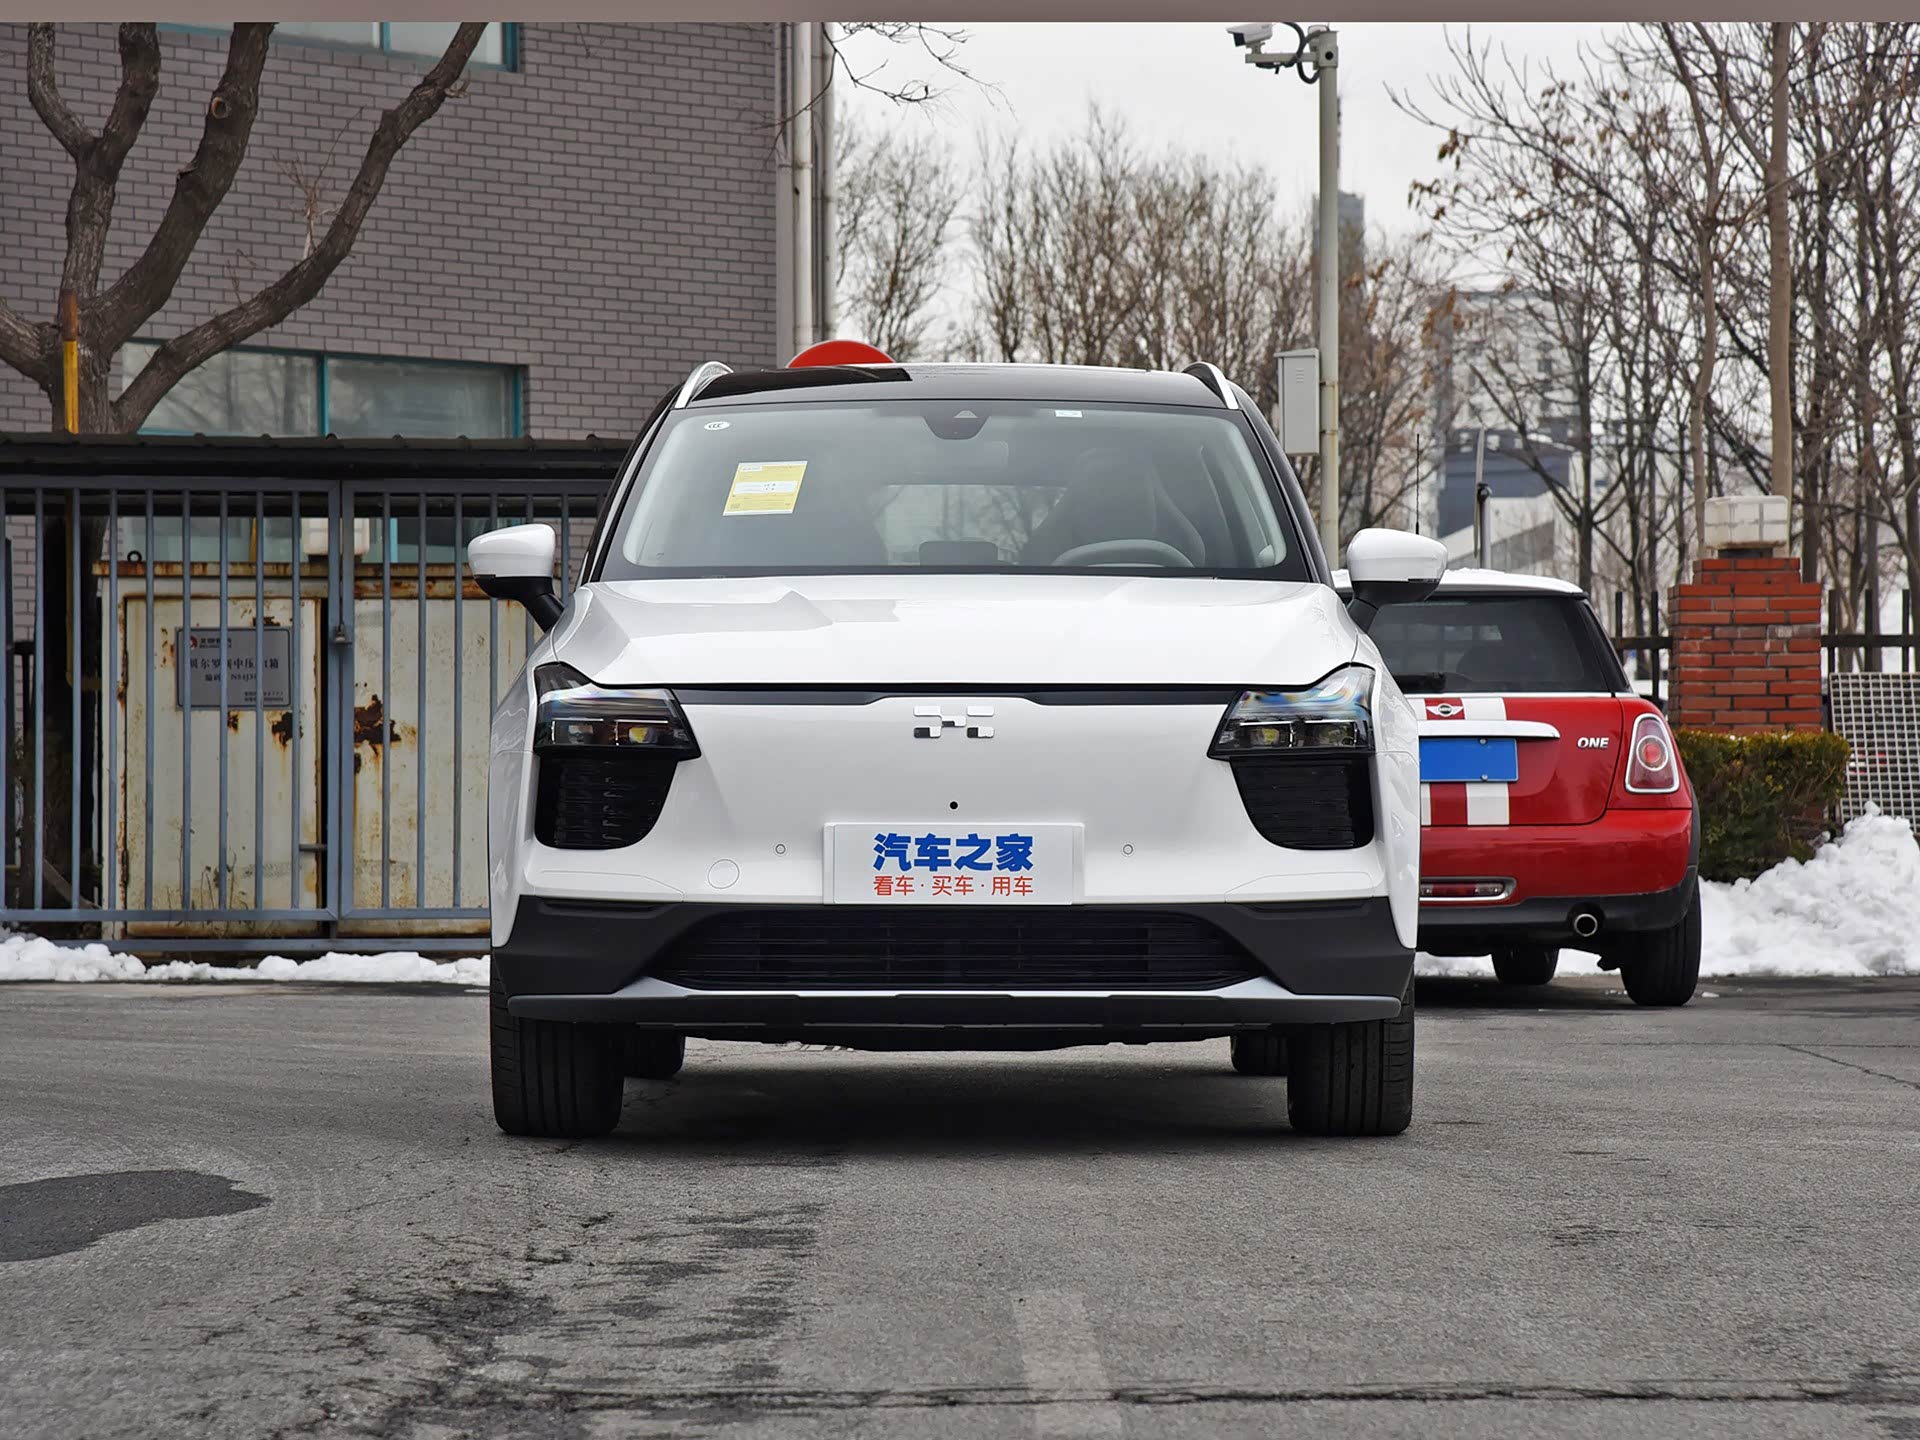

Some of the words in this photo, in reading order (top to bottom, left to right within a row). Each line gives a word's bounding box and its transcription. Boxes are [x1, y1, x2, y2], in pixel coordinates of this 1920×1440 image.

[1577, 737, 1609, 748] ONE
[873, 833, 1034, 872] 汽车之家
